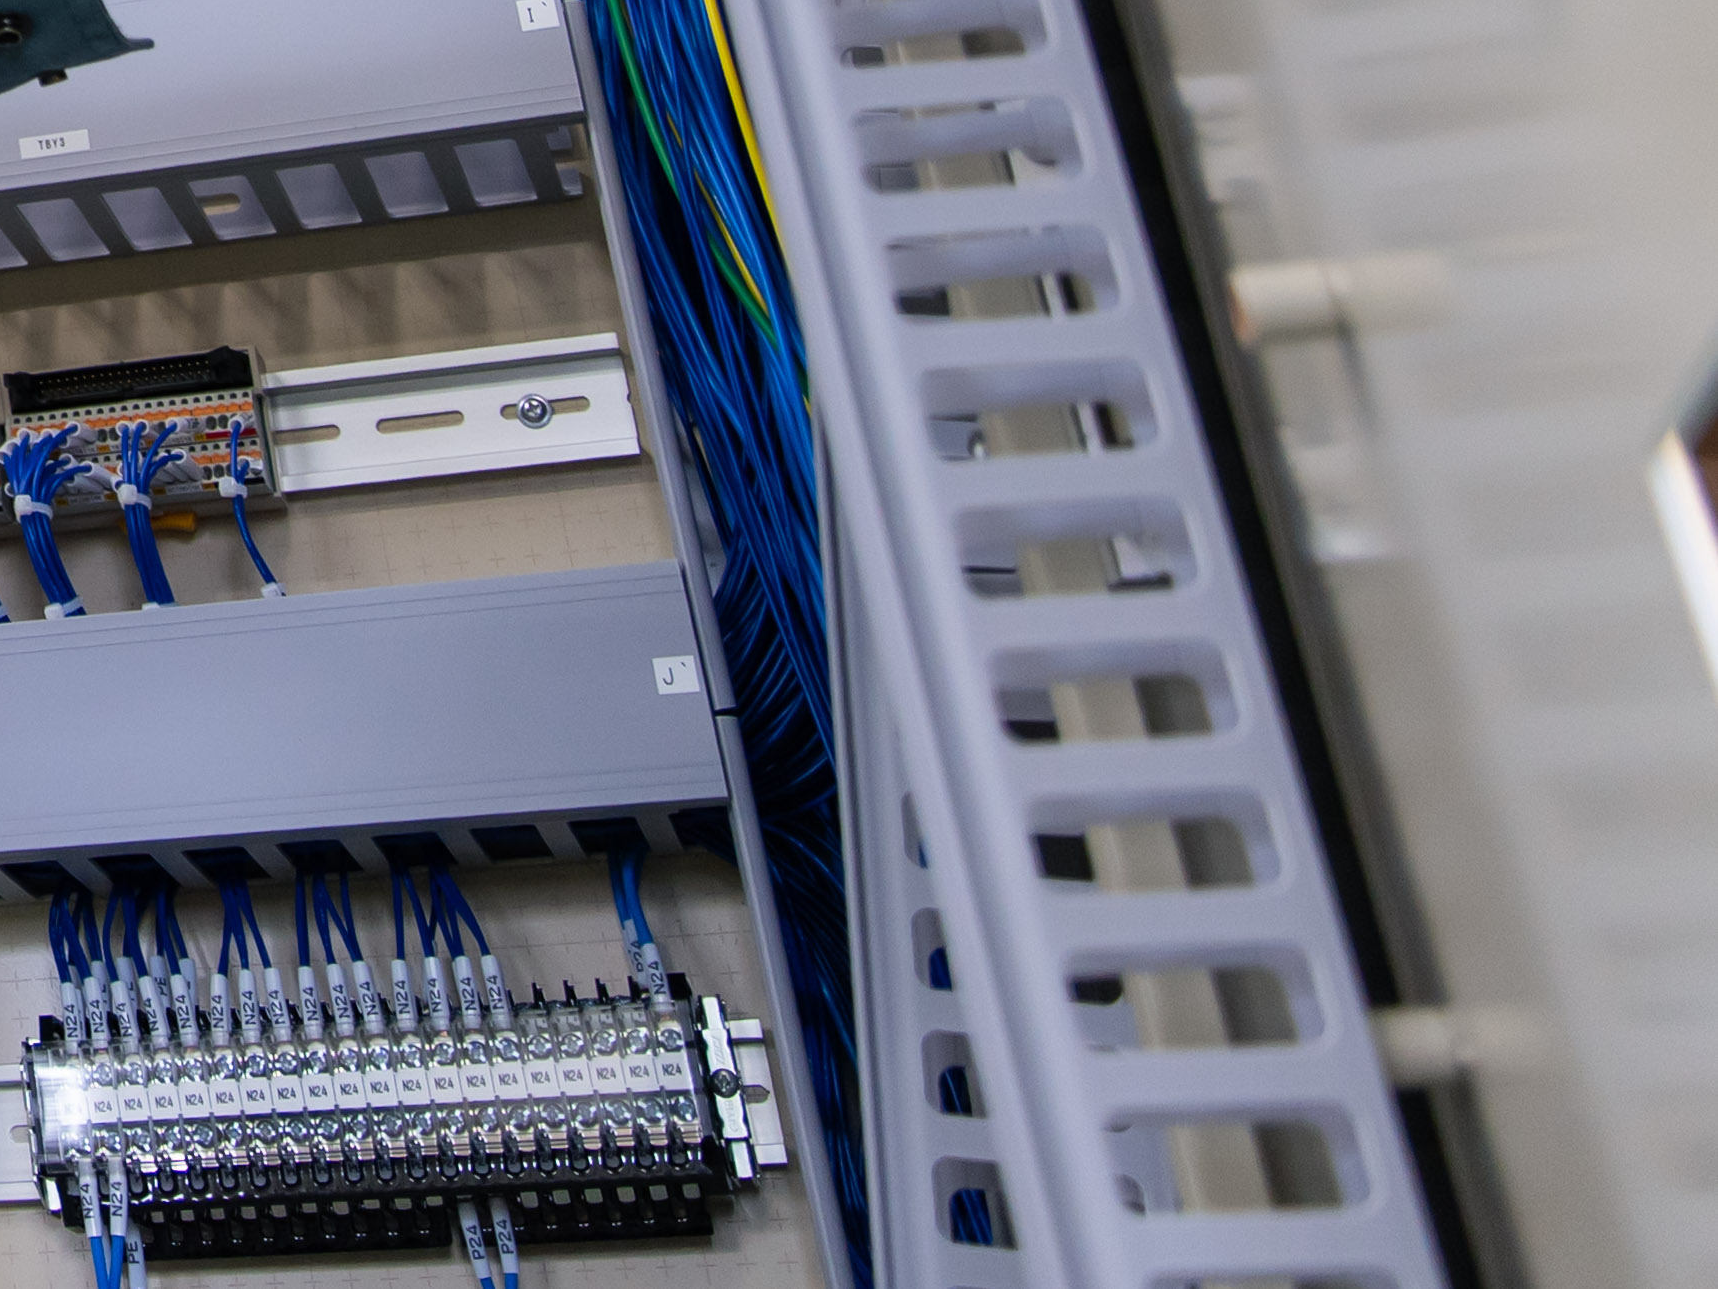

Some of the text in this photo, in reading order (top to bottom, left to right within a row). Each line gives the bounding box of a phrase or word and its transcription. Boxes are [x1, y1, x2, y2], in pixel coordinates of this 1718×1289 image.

[38, 137, 66, 151] TBY3
[427, 977, 444, 1013] N24
[461, 976, 477, 1012] N24
[486, 974, 505, 1010] N24
[647, 960, 667, 995] N24
[144, 996, 160, 1033] N24
[175, 994, 192, 1030] N24
[212, 994, 225, 1030] N24
[242, 989, 257, 1025] N24
[269, 989, 286, 1025] N24
[302, 986, 320, 1022] N24
[333, 983, 351, 1019] N24
[359, 980, 377, 1017] N24
[395, 979, 410, 1015] N24
[64, 1003, 79, 1039] N24
[91, 998, 106, 1034] N24
[116, 1001, 133, 1038] N24
[94, 1100, 112, 1113] N24
[124, 1097, 143, 1110] N24
[154, 1095, 173, 1108] N24
[185, 1093, 204, 1106] N24
[215, 1091, 234, 1104] N24
[246, 1089, 265, 1103] N24
[277, 1087, 296, 1100] N24
[308, 1085, 327, 1098] N24
[340, 1083, 359, 1095] N24
[370, 1081, 390, 1093] N24
[402, 1079, 422, 1092] N24
[434, 1077, 454, 1090] N24
[466, 1074, 486, 1088] N24
[498, 1072, 518, 1086] N24
[531, 1071, 551, 1084] N24
[564, 1068, 583, 1082] N24
[596, 1066, 617, 1080] N24
[629, 1064, 650, 1077] N24
[661, 1062, 682, 1076] N24
[80, 1183, 95, 1219] N24
[110, 1181, 123, 1217] N24
[127, 1241, 140, 1264] PE
[466, 1224, 485, 1260] P24
[496, 1218, 514, 1254] P24
